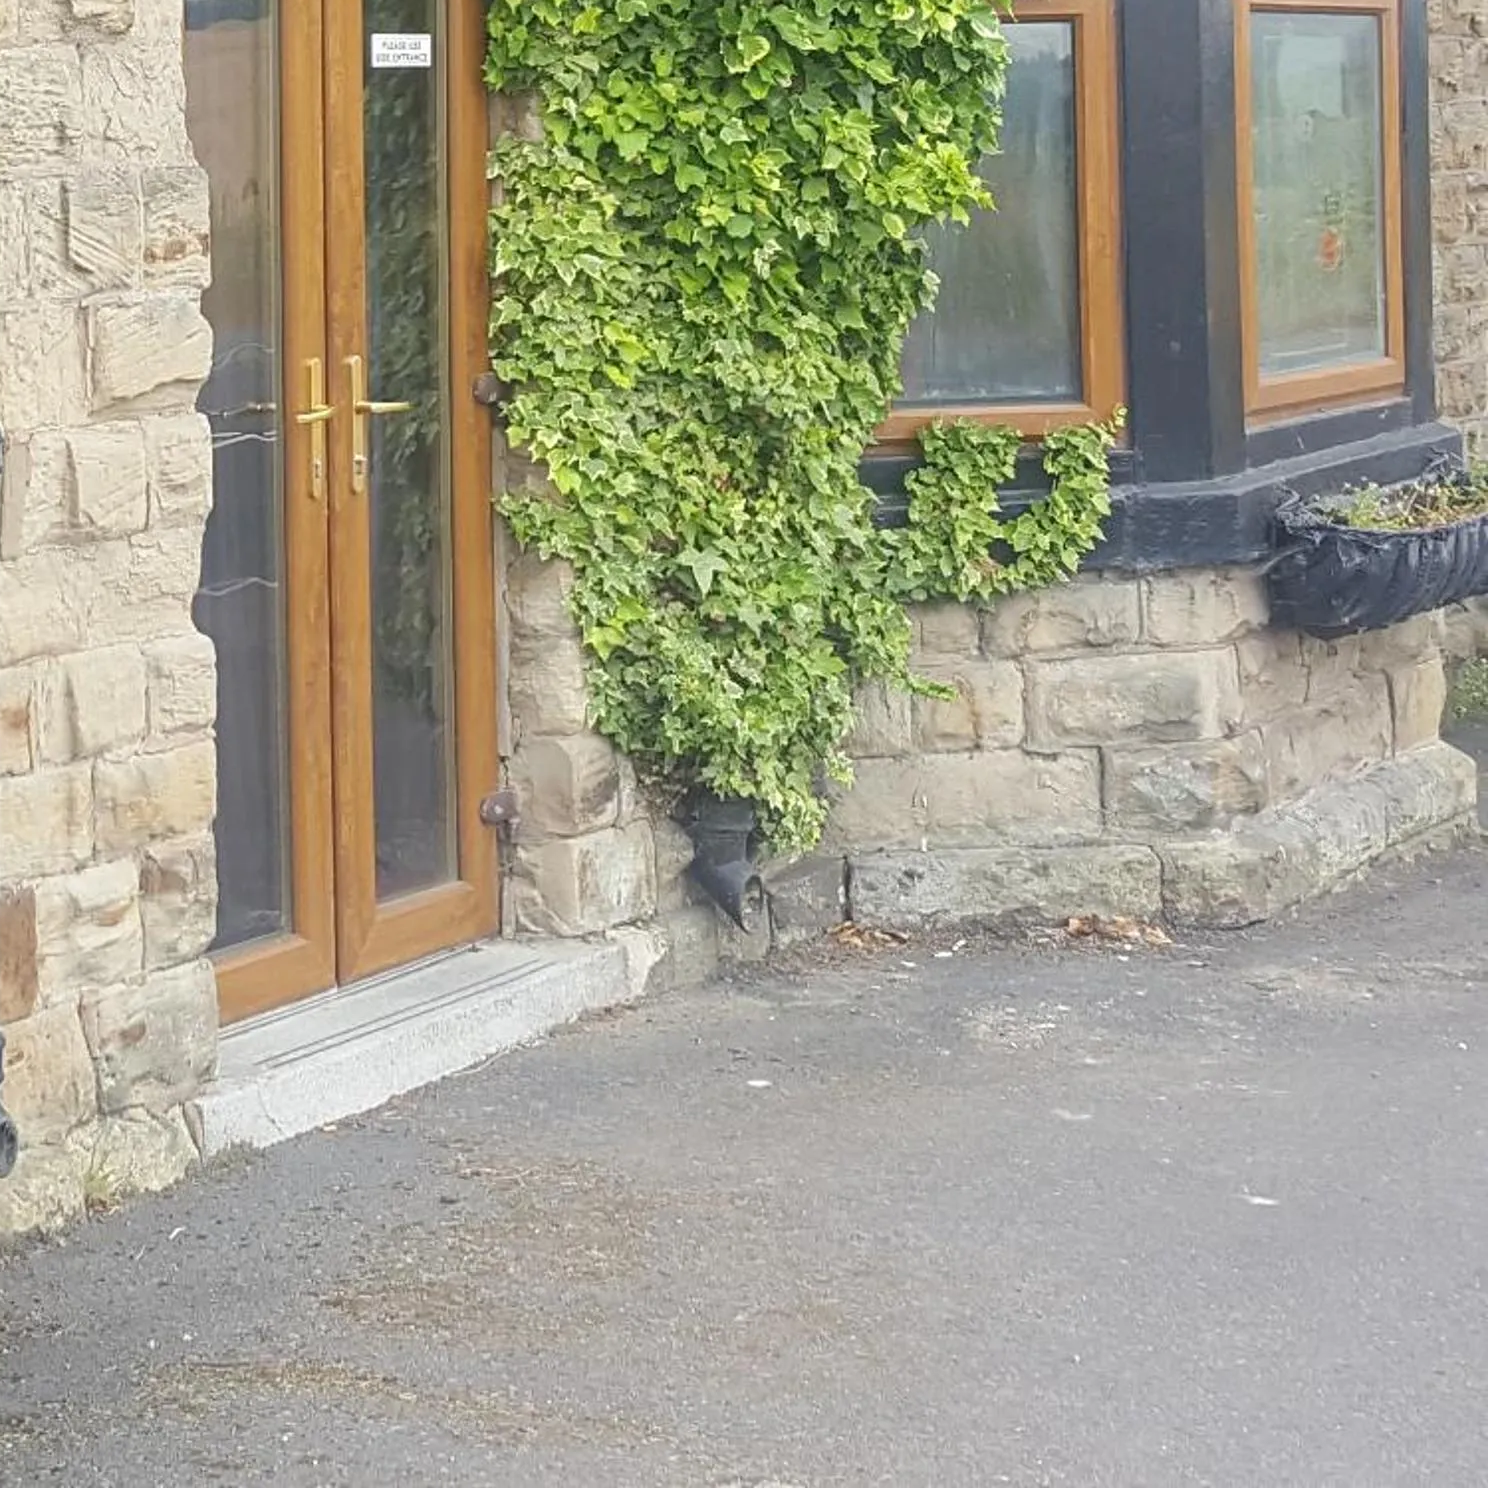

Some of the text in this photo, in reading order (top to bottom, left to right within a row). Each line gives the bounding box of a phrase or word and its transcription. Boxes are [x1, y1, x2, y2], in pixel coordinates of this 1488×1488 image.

[381, 40, 421, 50] PLEASE USE
[392, 53, 428, 63] ENTRANCE
